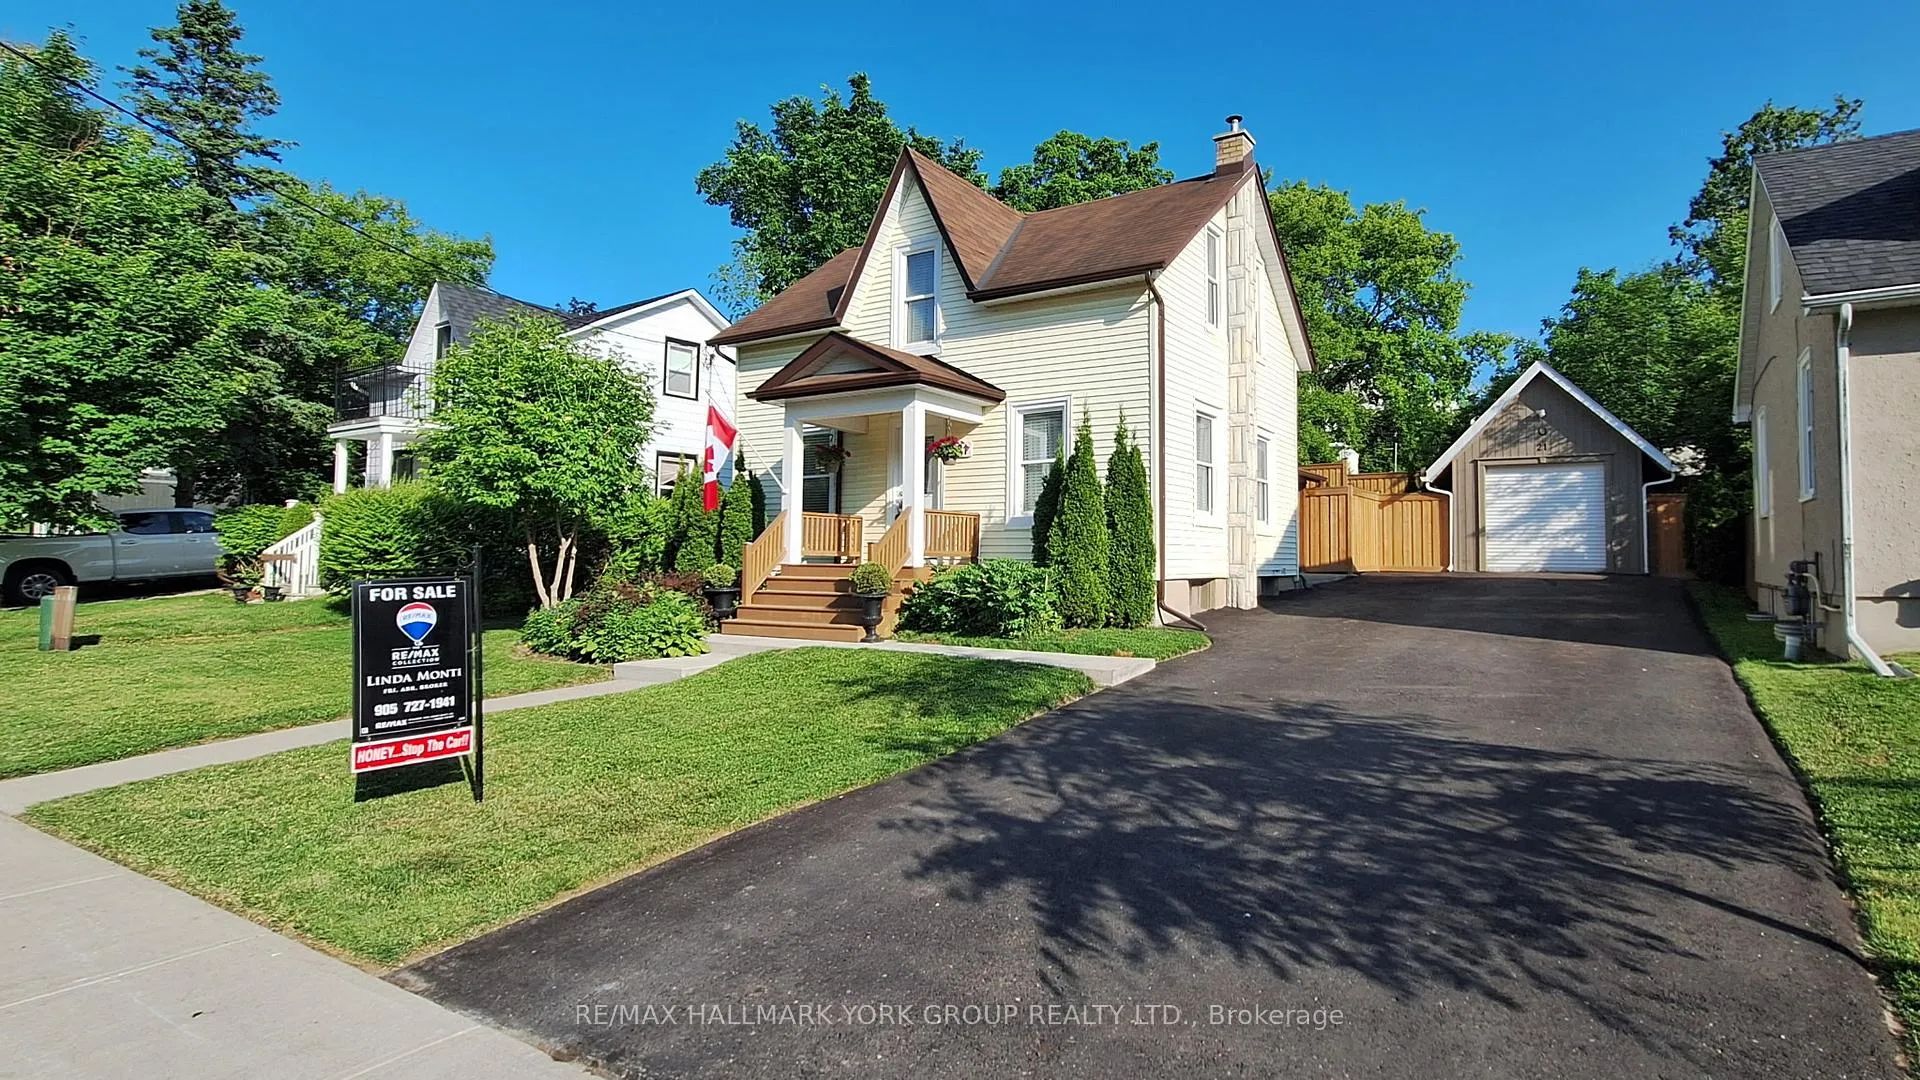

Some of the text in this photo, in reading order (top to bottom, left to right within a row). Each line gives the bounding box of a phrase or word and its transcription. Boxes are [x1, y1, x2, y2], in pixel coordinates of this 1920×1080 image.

[1536, 443, 1547, 452] 21
[370, 586, 456, 601] FOR SALE
[402, 612, 432, 621] RE/MAX
[392, 648, 439, 660] RE/MAX
[392, 657, 439, 665] COLLECTION
[367, 668, 461, 686] LINDA MONTI
[374, 696, 455, 716] 905 727-1941
[427, 739, 444, 752] The
